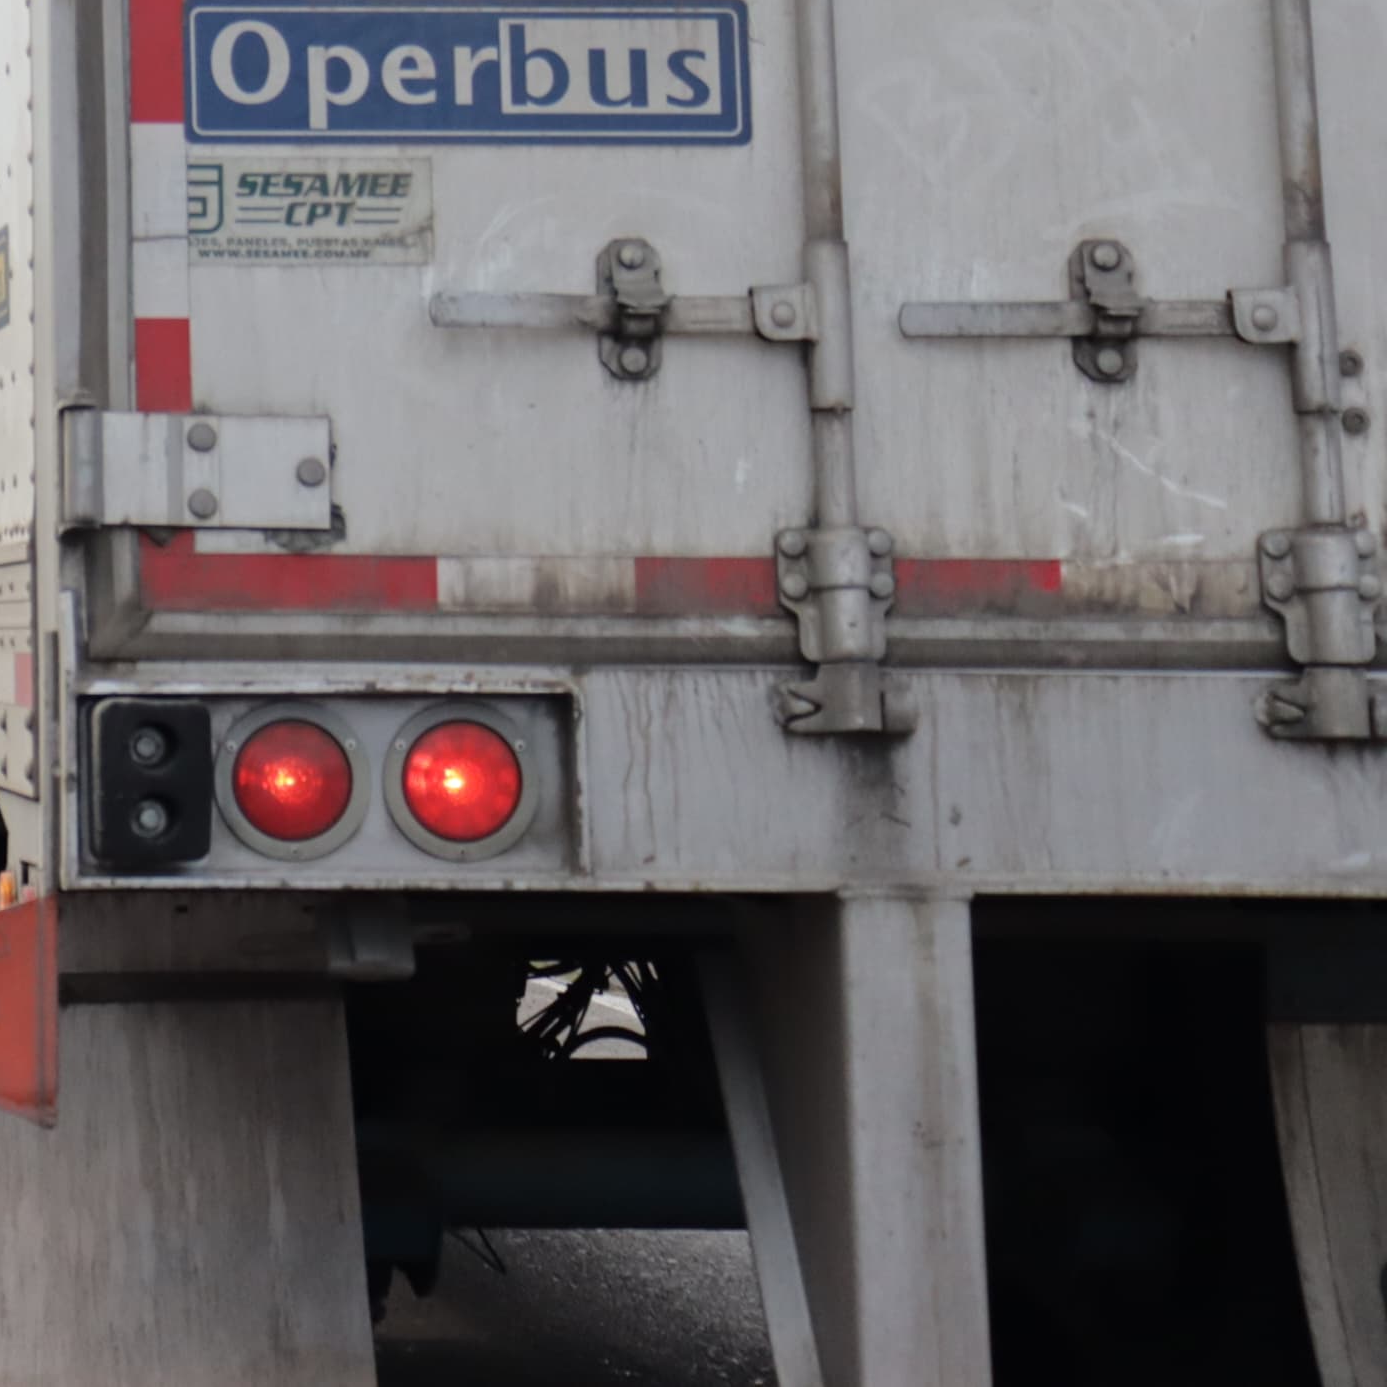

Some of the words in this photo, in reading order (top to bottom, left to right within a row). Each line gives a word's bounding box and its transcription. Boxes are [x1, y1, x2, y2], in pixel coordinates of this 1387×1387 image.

[210, 17, 712, 130] Operbus
[235, 173, 413, 198] SESAMEE
[285, 202, 357, 227] CPT
